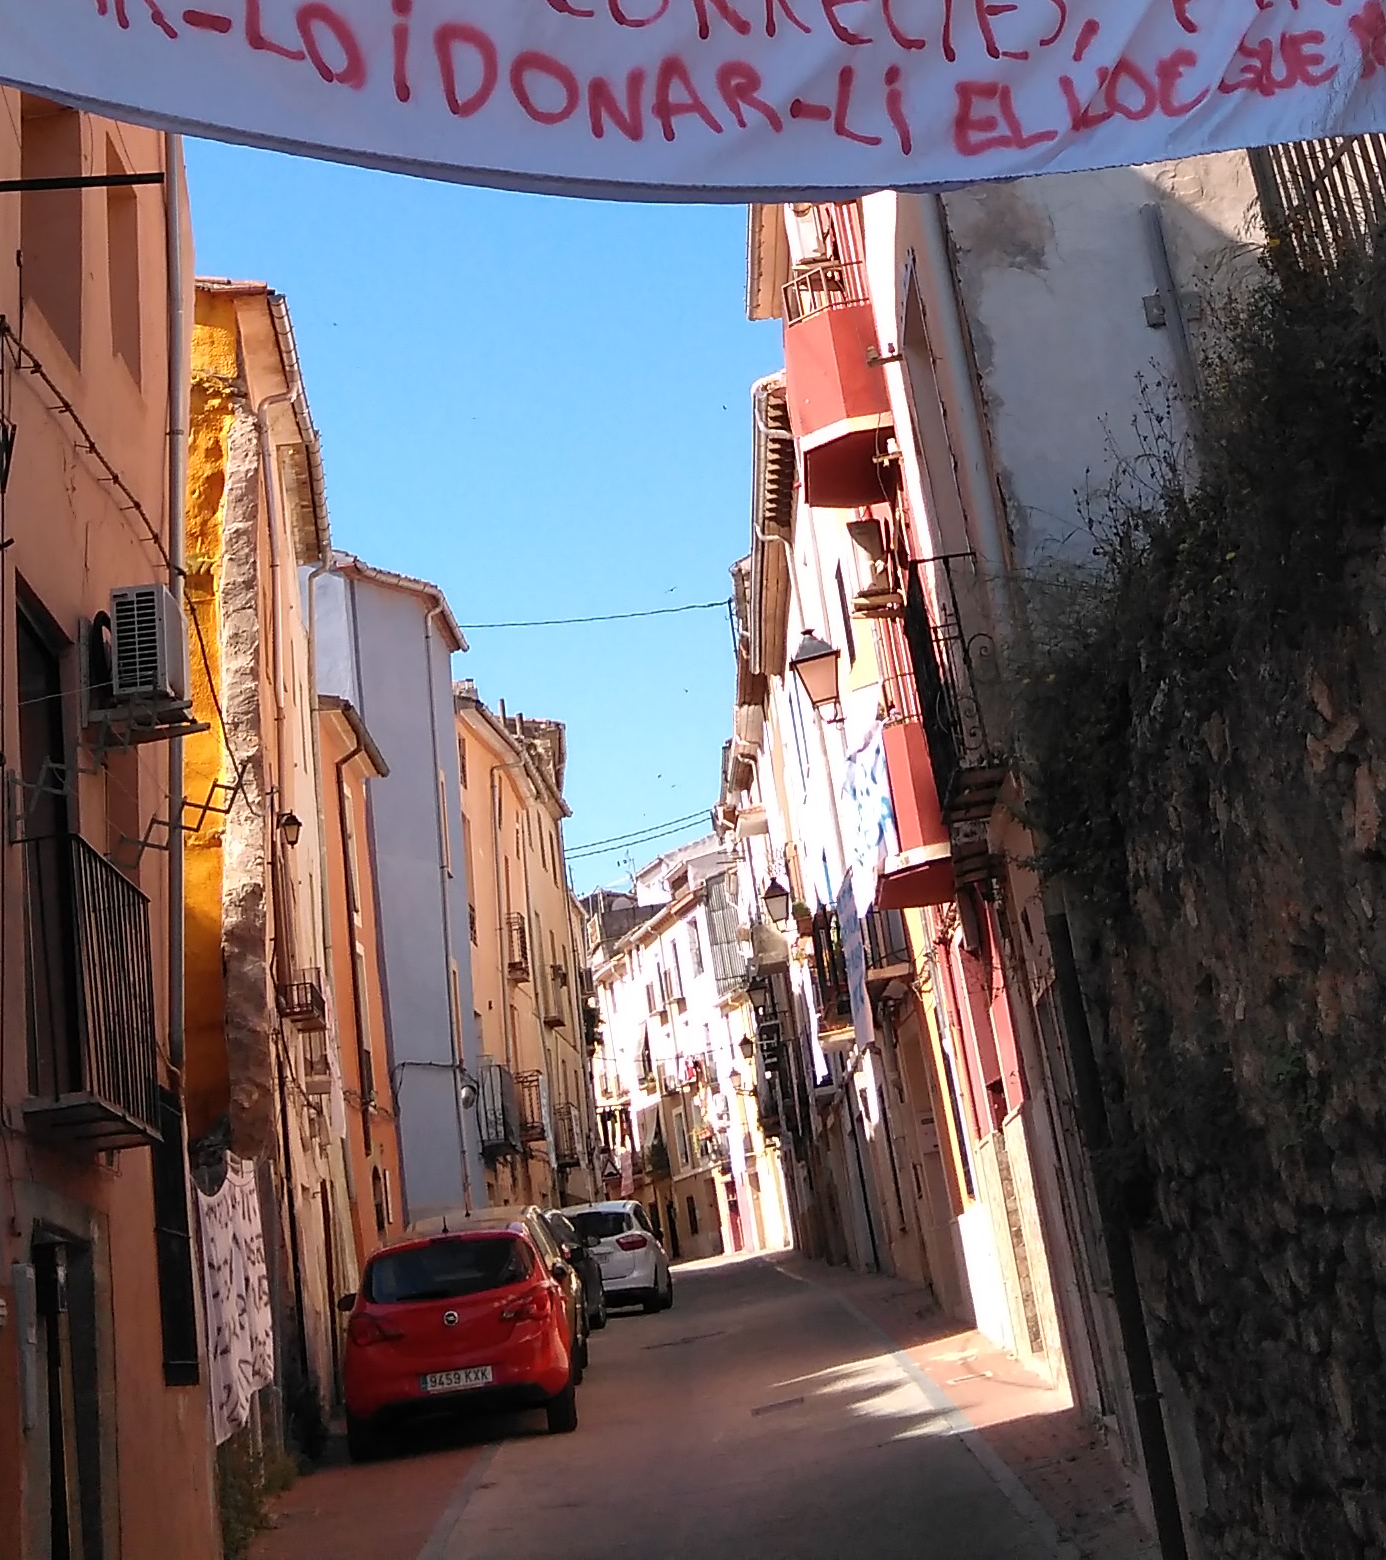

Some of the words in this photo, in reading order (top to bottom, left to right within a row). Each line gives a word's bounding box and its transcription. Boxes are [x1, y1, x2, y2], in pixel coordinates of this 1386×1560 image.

[953, 78, 1059, 157] EL
[429, 1371, 461, 1388] 9459
[464, 1368, 489, 1383] KXK
